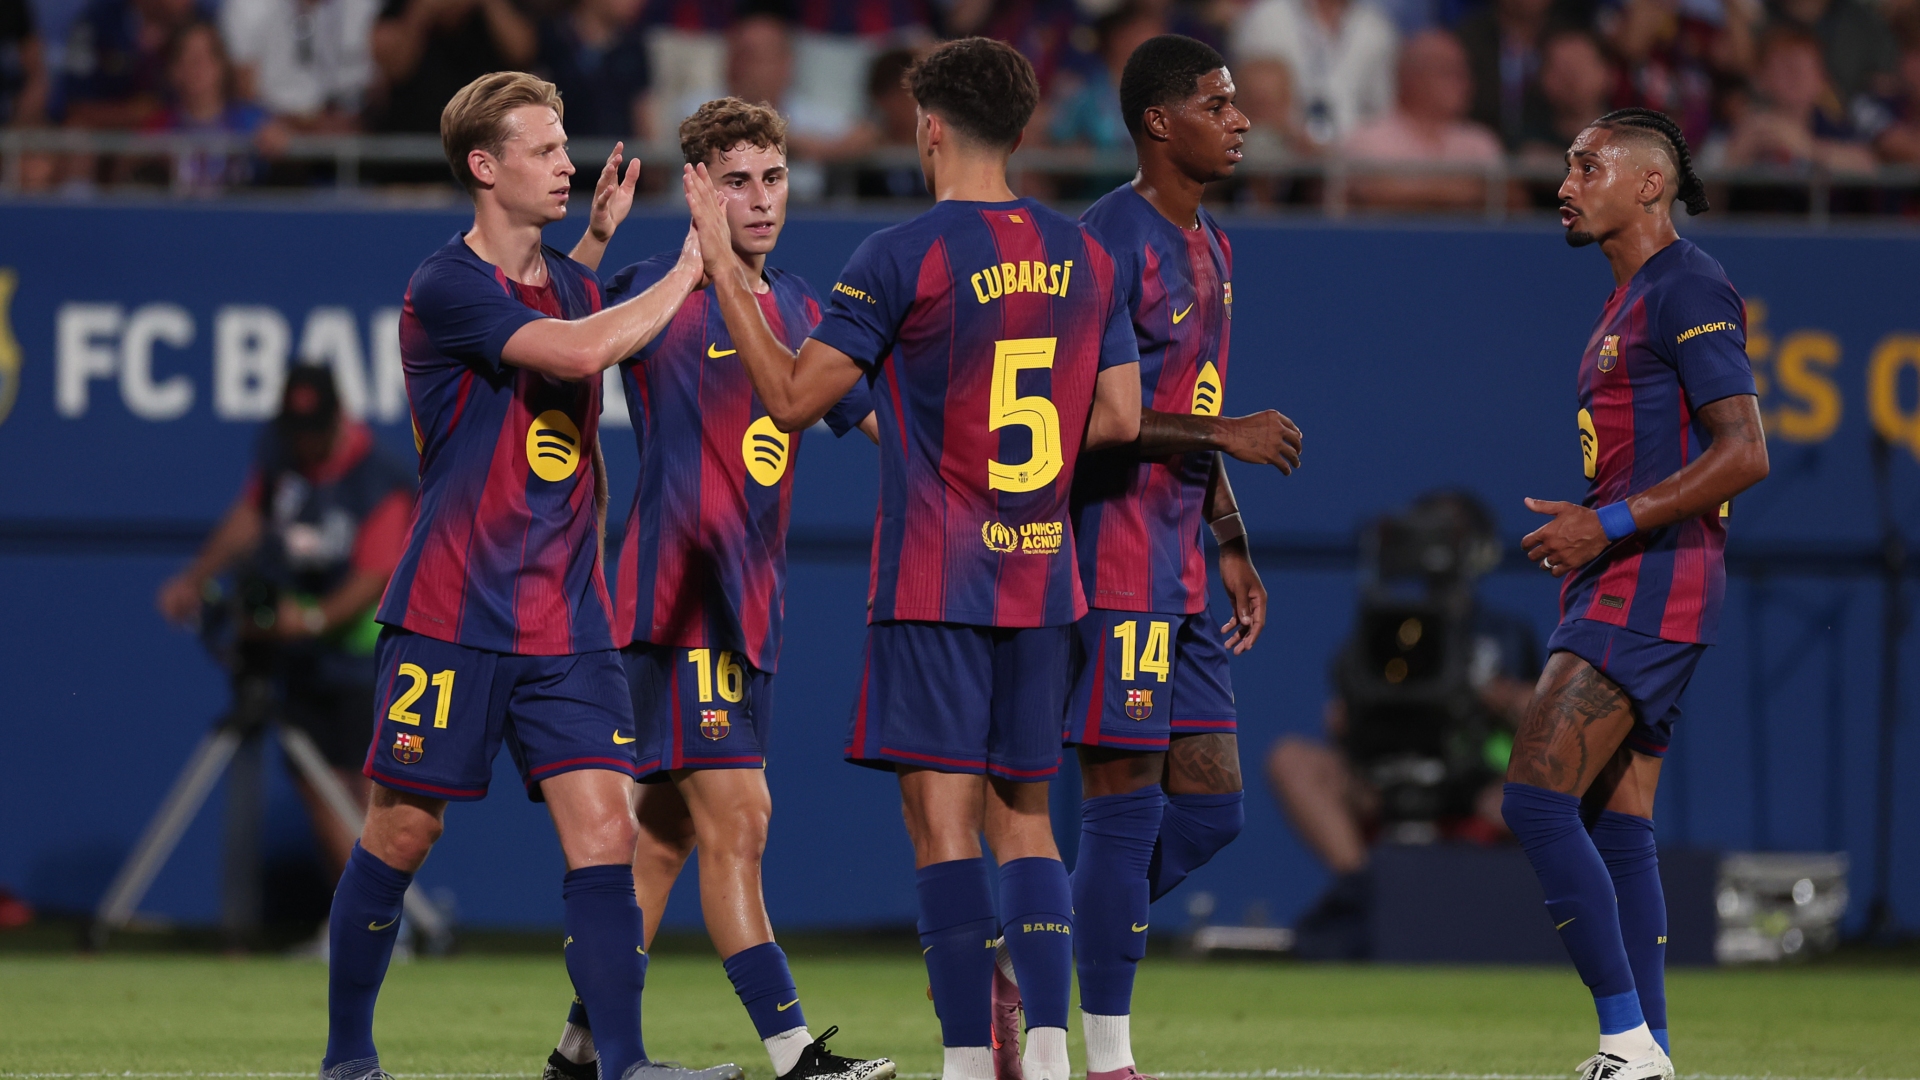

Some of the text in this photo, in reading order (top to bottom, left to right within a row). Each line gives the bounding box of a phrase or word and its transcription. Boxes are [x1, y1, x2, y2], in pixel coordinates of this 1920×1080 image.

[867, 295, 877, 305] tv
[971, 260, 1073, 304] CUBARSÍ
[1676, 321, 1736, 344] AMBILIGHT tv
[55, 302, 195, 420] FC
[988, 337, 1064, 493] 5
[1020, 521, 1063, 537] UNHCR
[1021, 534, 1062, 550] ACNUR
[1113, 620, 1170, 683] 14
[388, 663, 456, 729] 21
[688, 648, 744, 703] 16
[1023, 922, 1071, 935] BARÇA
